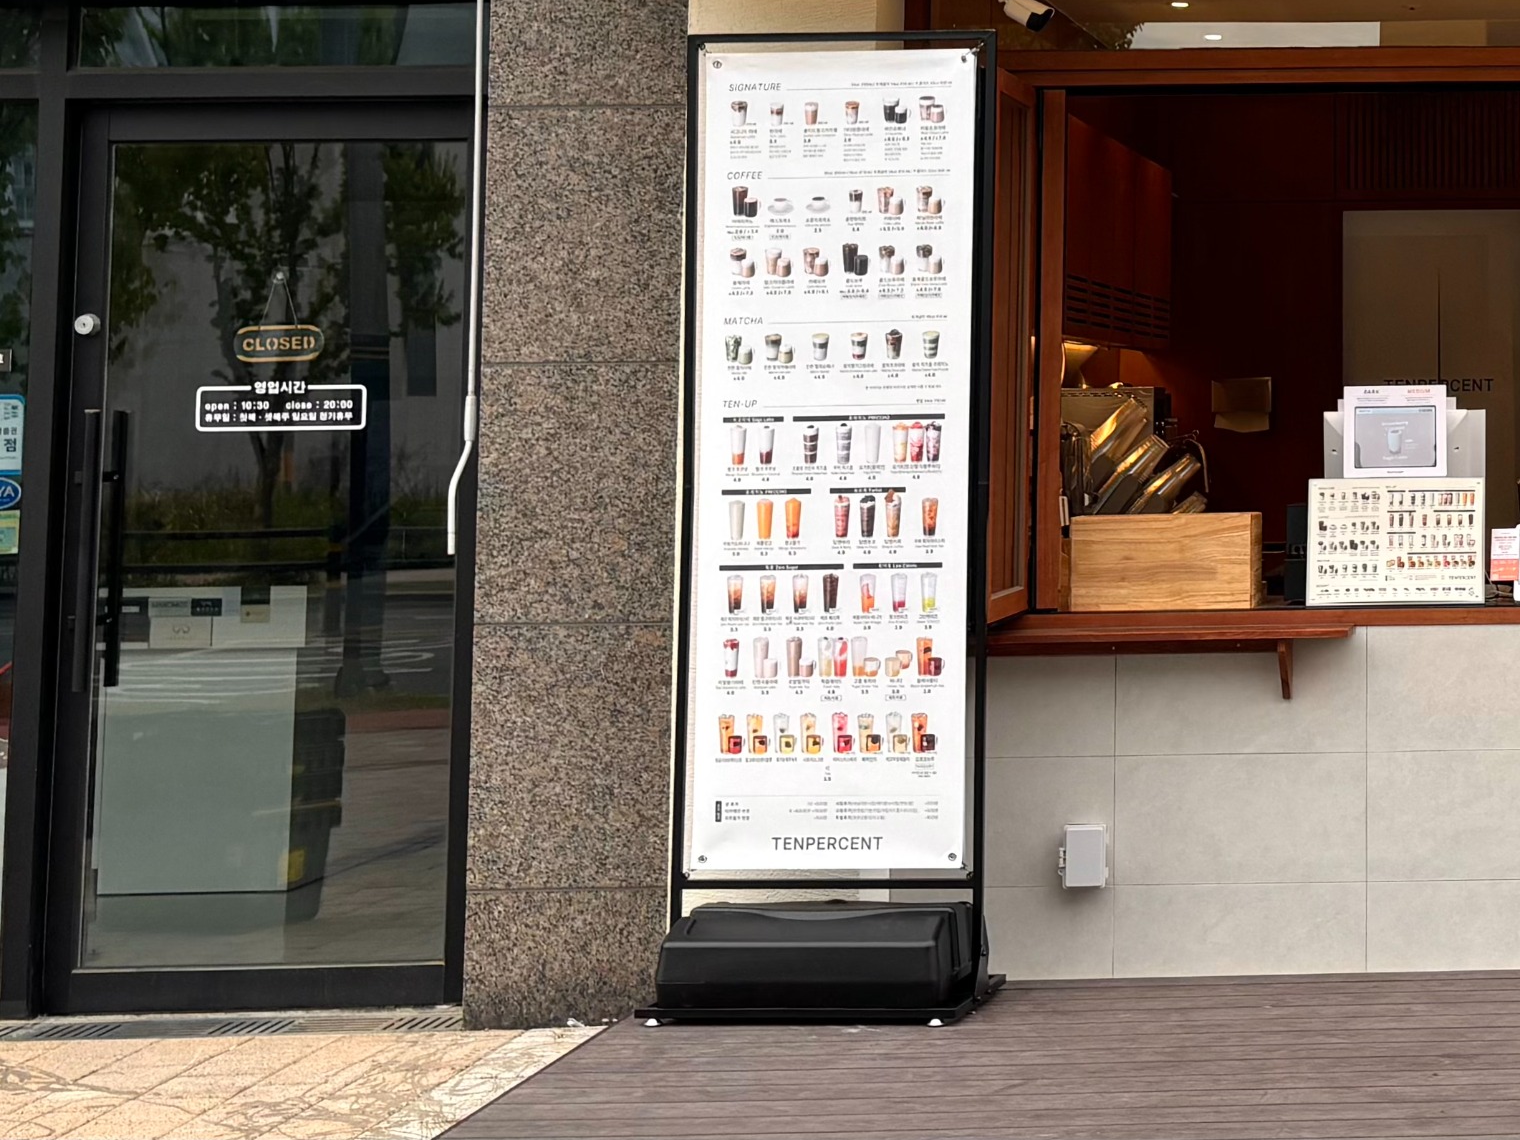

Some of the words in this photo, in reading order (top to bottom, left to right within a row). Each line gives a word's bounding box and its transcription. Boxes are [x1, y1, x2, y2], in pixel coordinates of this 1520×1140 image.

[729, 83, 781, 92] SIGNATURE
[727, 172, 762, 180] COFFEE
[724, 316, 764, 325] MATCHA
[243, 336, 315, 351] CLOSED
[254, 381, 306, 394] 영업시간
[723, 400, 757, 408] TEN-UP
[771, 836, 883, 851] TENPERCENT
